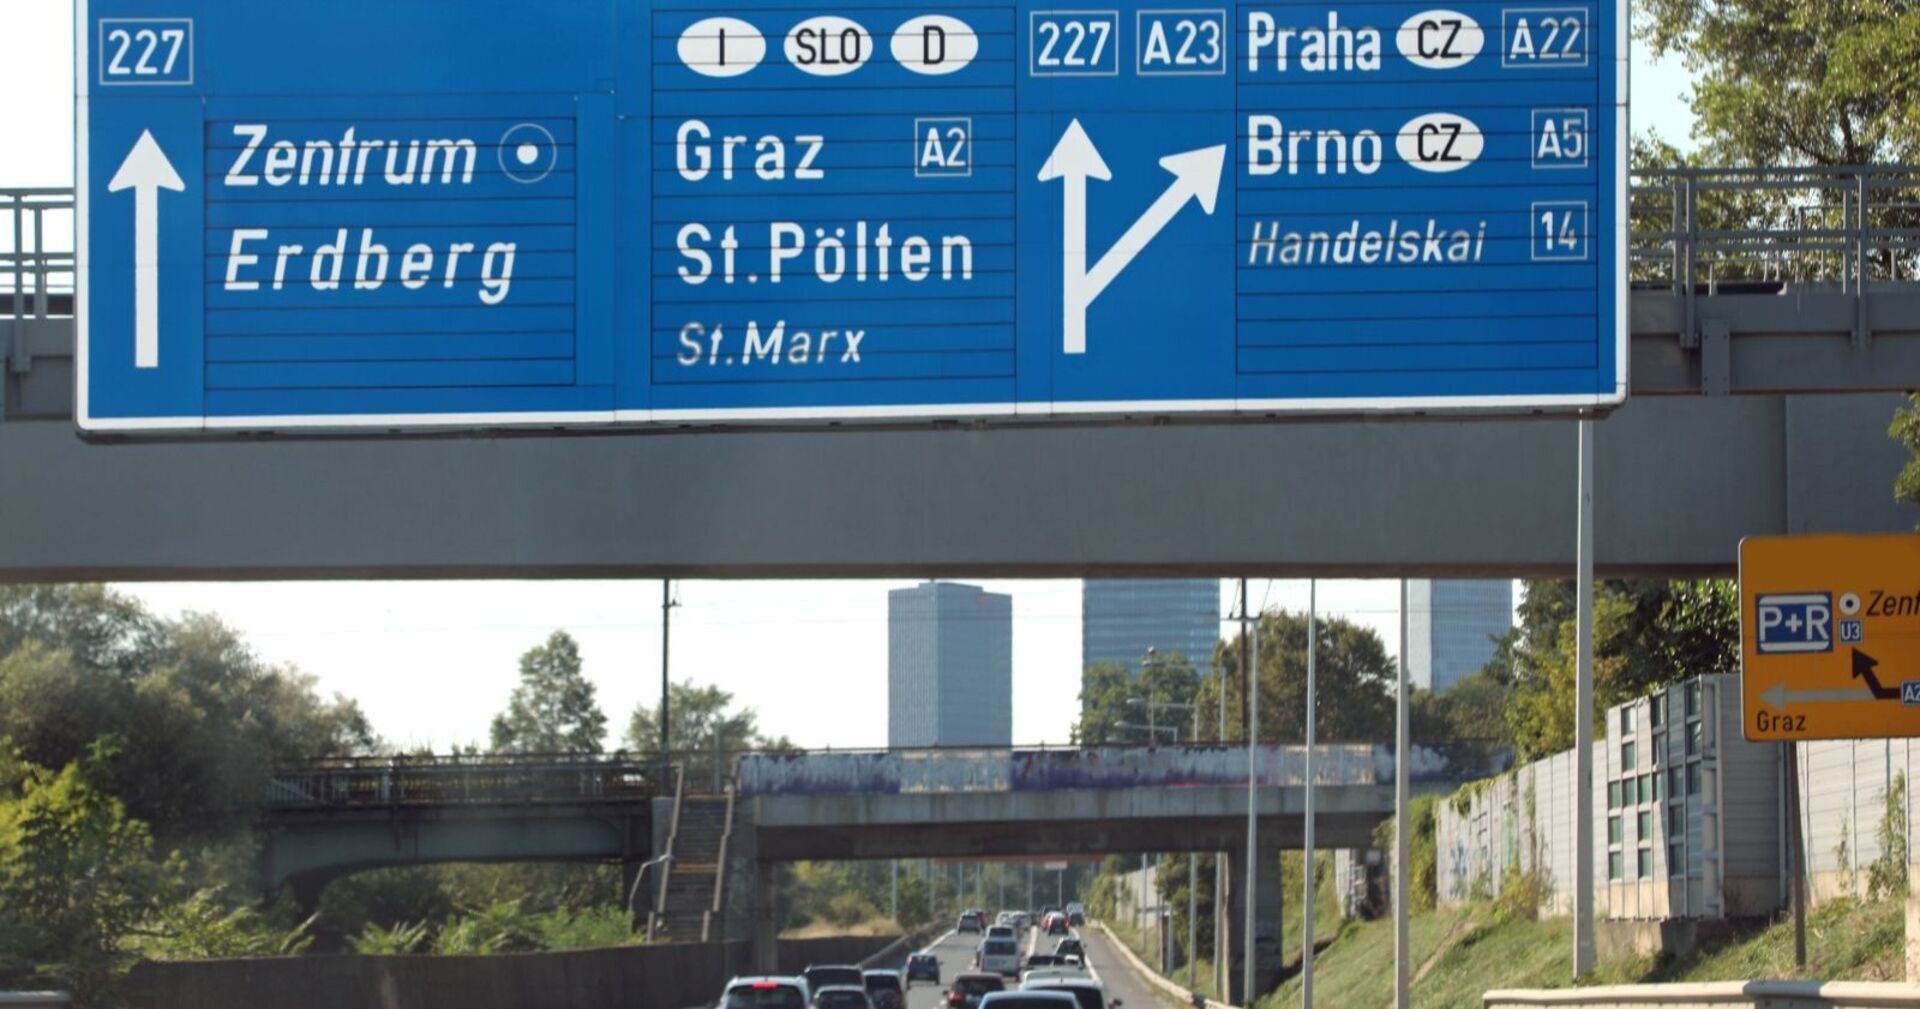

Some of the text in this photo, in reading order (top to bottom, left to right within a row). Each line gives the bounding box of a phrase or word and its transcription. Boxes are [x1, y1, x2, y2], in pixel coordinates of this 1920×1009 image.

[108, 29, 184, 75] 227
[718, 25, 946, 66] I SLO D
[1038, 20, 1220, 66] 227 A23
[1248, 11, 1580, 72] Praha CZ A22
[225, 124, 477, 186] Zentrum
[676, 119, 966, 181] Graz A2
[1248, 115, 1582, 175] Brno CZ A5
[1248, 211, 1577, 264] Handelskai 14
[225, 228, 516, 305] Erdberg
[1759, 604, 1829, 641] P+R
[1841, 622, 1861, 640] U3
[1757, 709, 1806, 732] Graz
